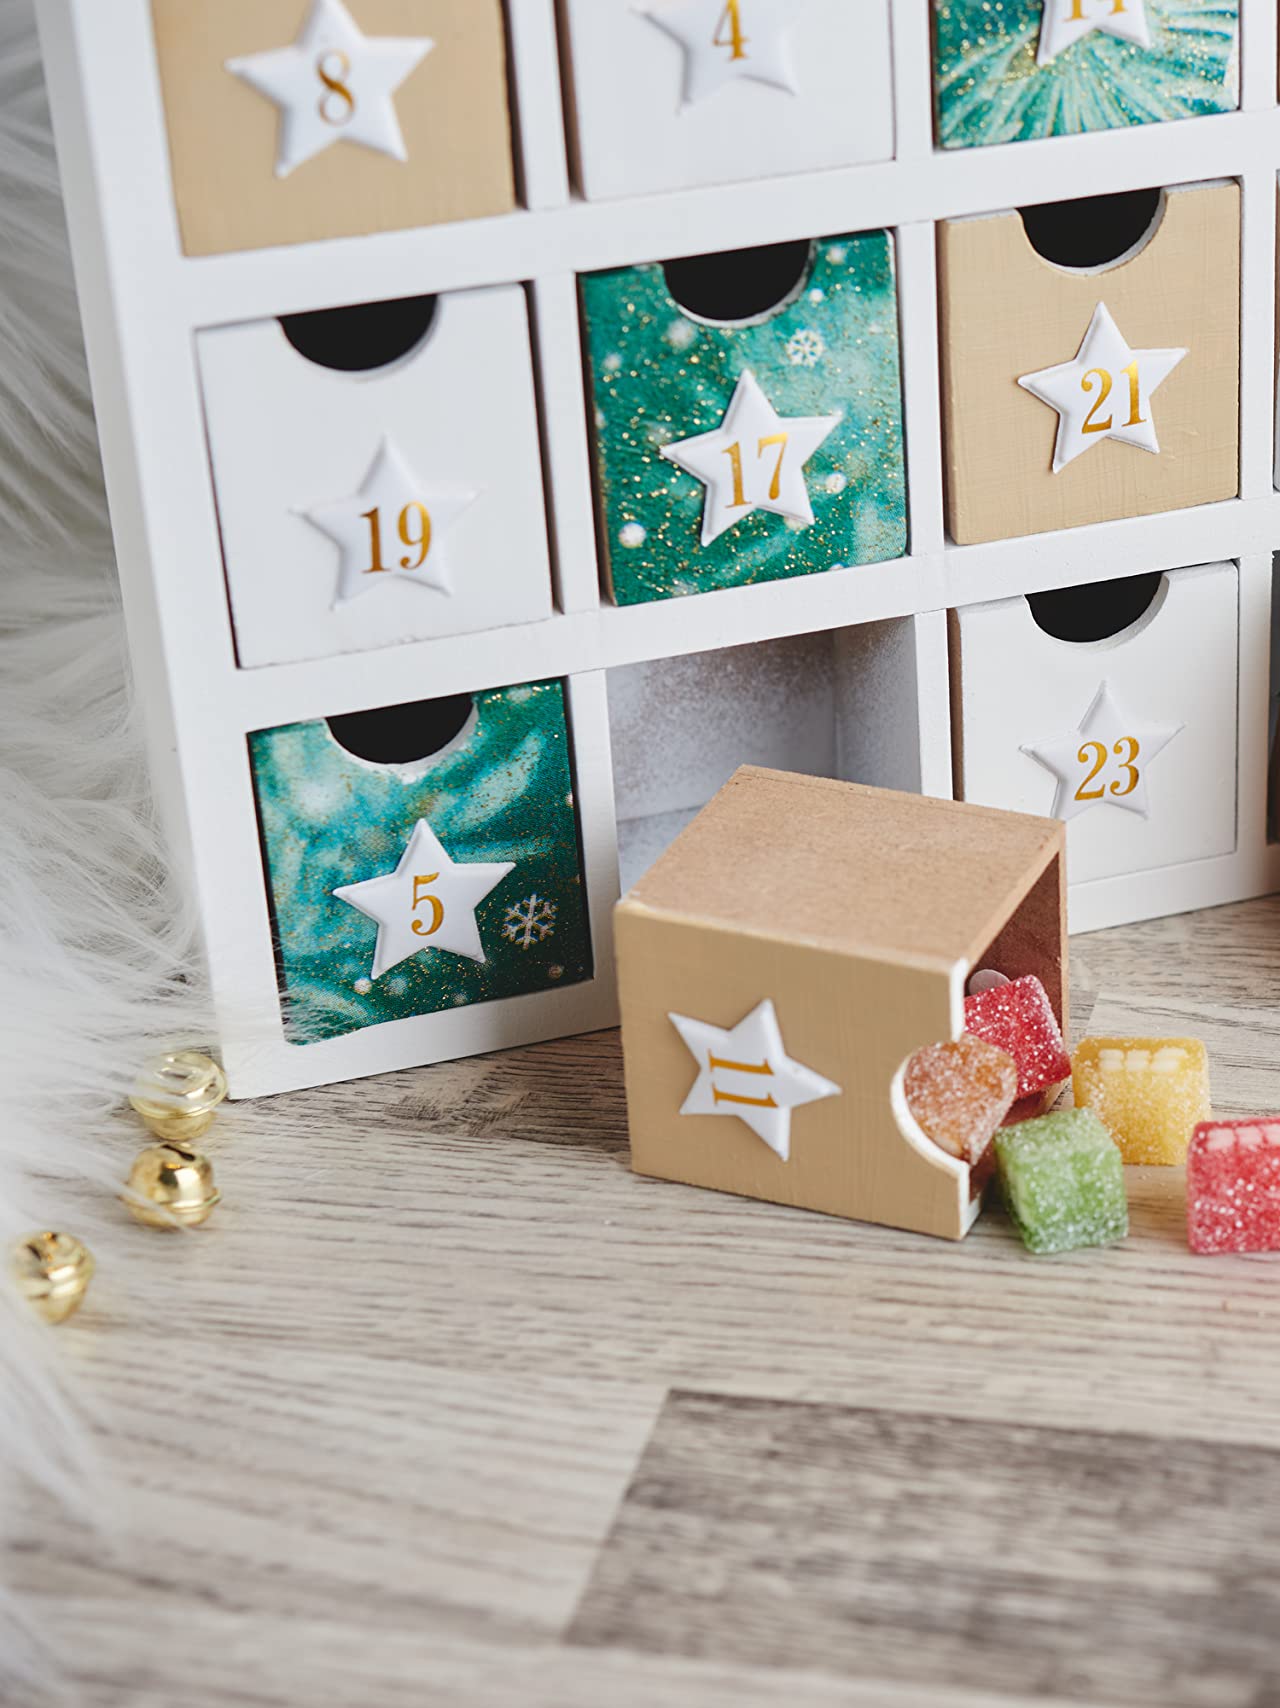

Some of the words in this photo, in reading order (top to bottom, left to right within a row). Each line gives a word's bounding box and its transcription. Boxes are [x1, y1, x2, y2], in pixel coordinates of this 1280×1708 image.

[713, 0, 748, 60] 4
[316, 48, 353, 126] 8
[1080, 359, 1148, 434] 21
[721, 432, 788, 507] 17
[363, 502, 432, 573] 19
[1073, 736, 1140, 801] 23
[411, 872, 445, 936] 5
[707, 1048, 779, 1110] 11
